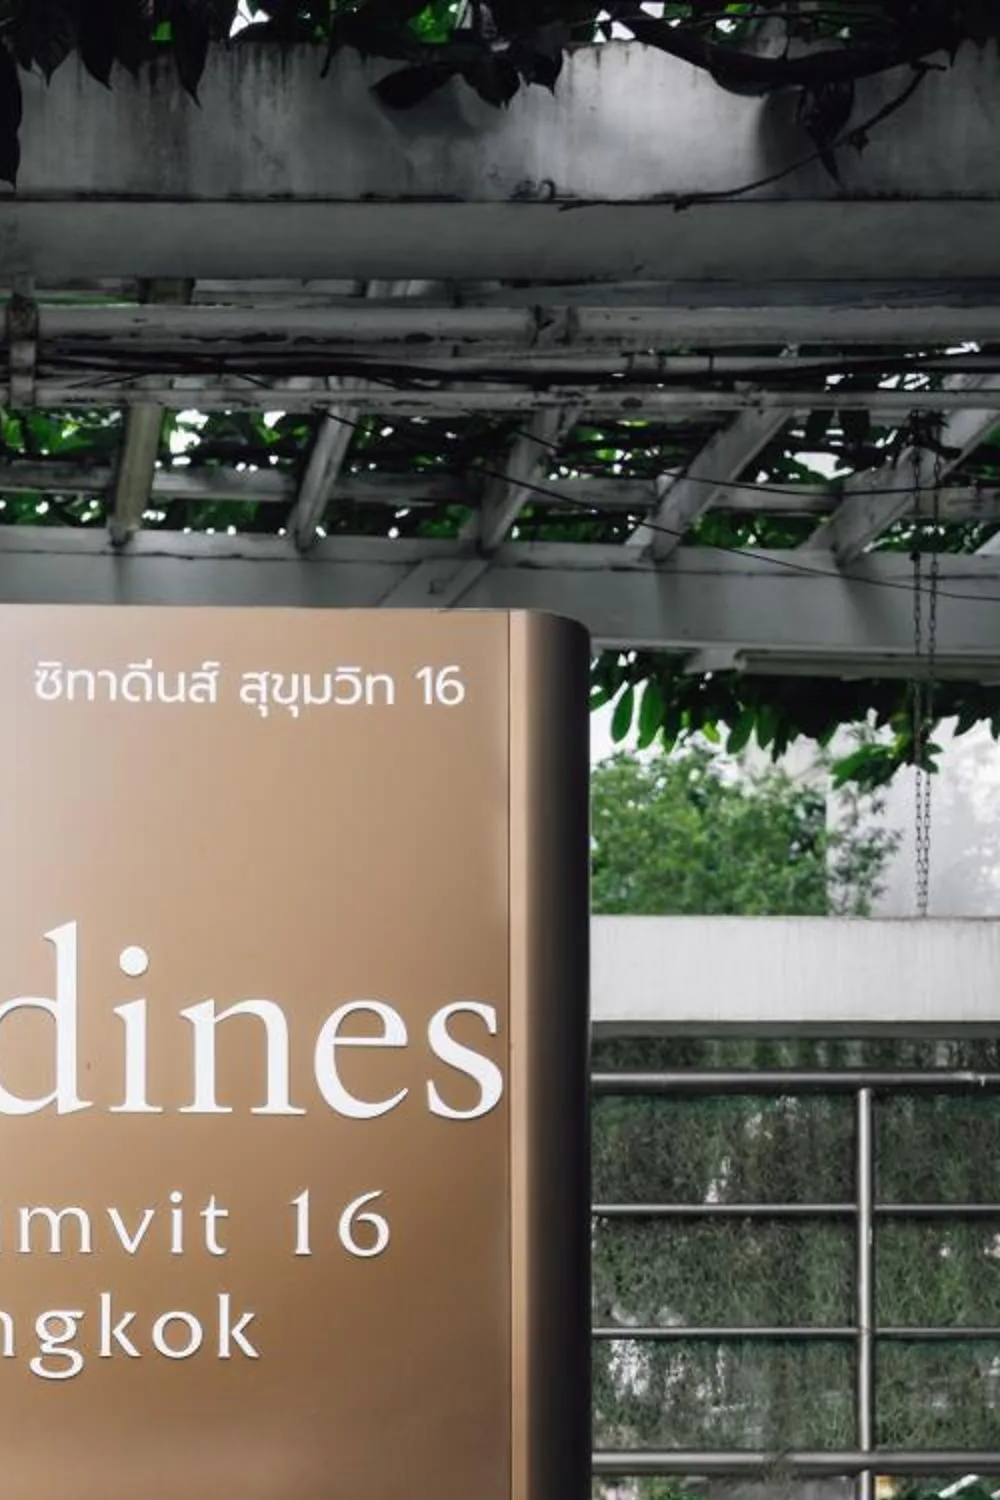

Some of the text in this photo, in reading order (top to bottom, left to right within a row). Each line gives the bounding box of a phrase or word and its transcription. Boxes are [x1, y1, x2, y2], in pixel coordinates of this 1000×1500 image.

[34, 657, 466, 718] ซิทาดีนส์ สุขุมวิท 16
[290, 1189, 391, 1258] 16
